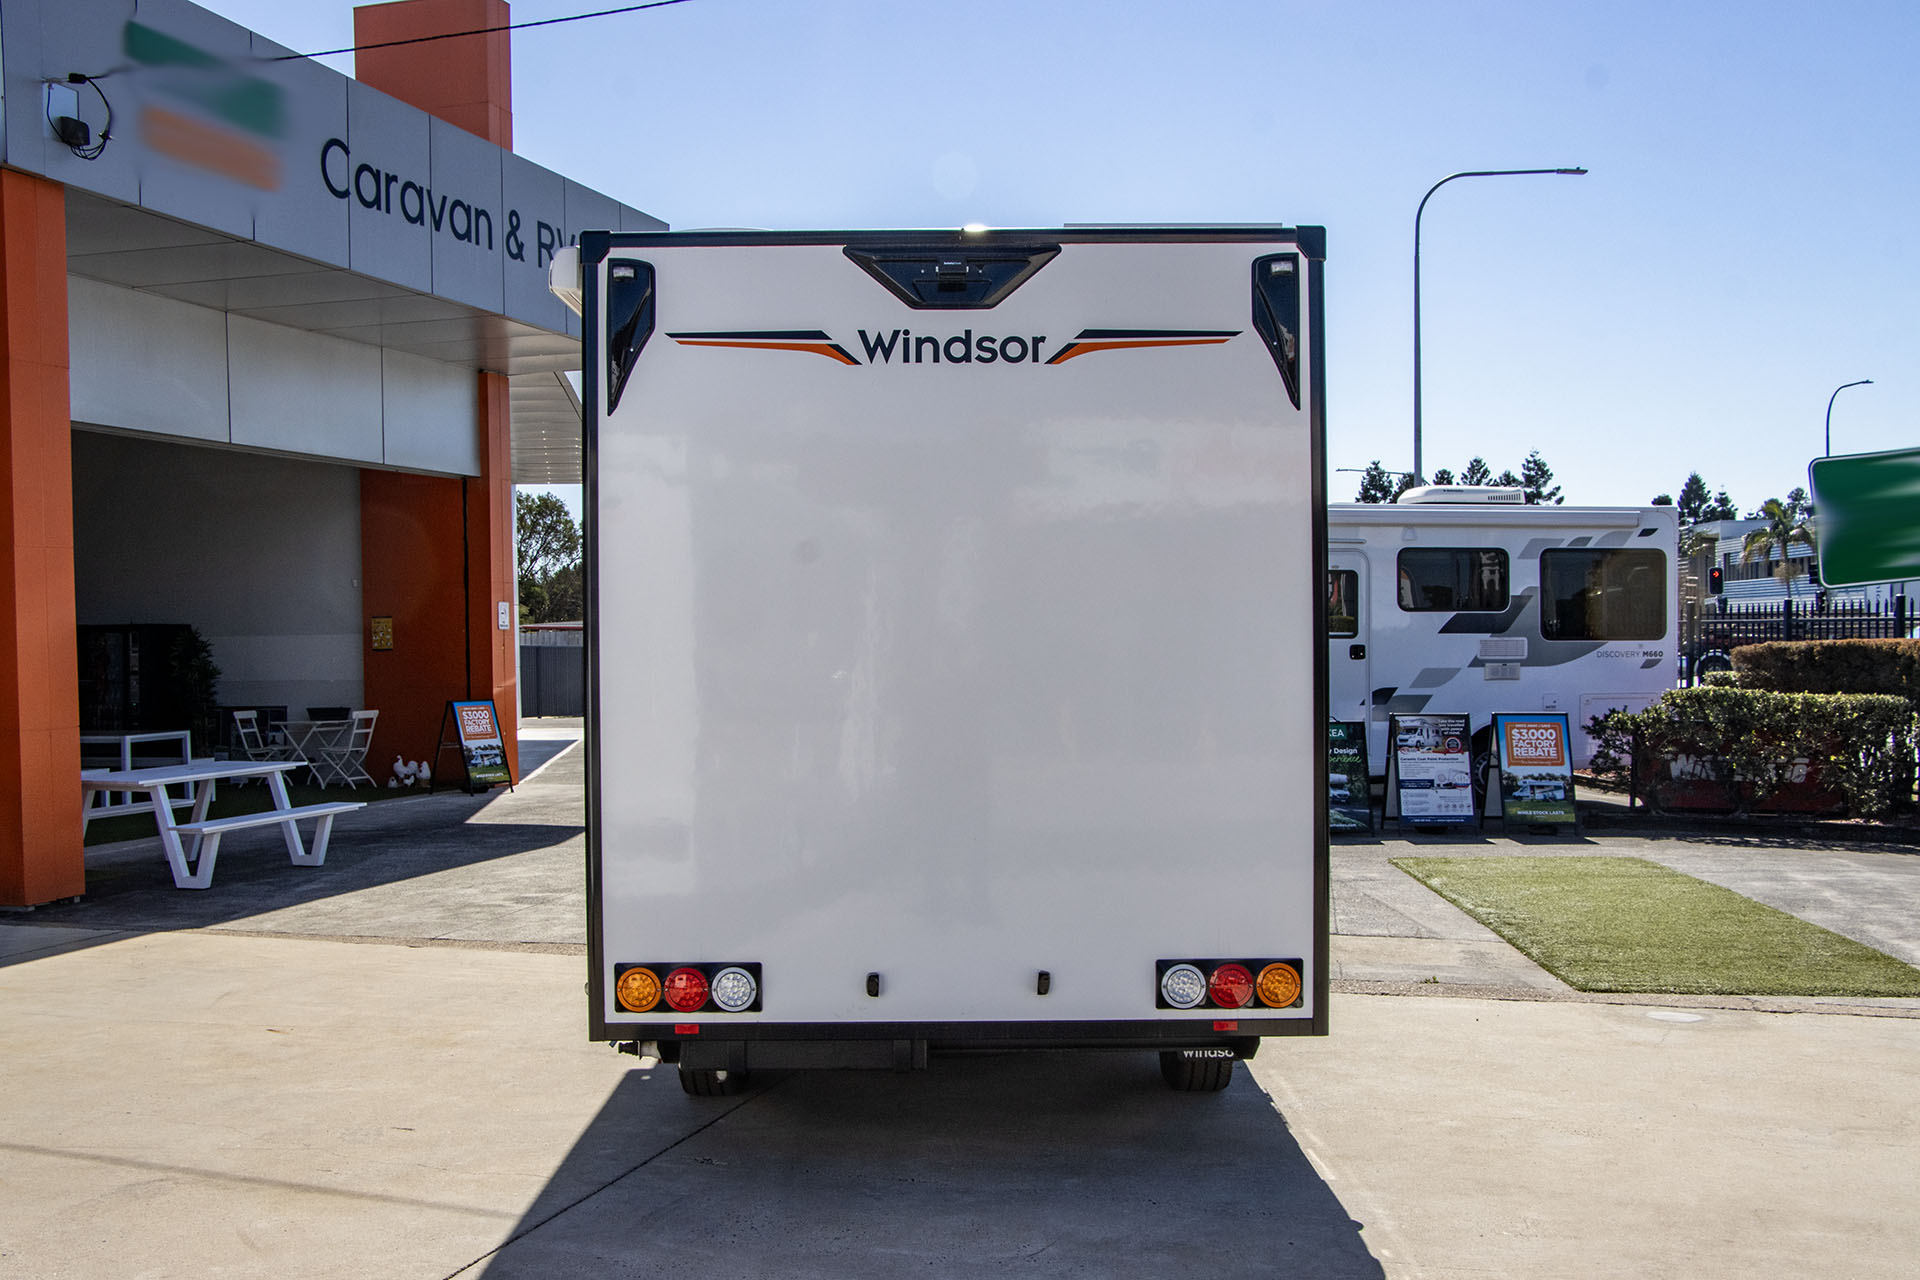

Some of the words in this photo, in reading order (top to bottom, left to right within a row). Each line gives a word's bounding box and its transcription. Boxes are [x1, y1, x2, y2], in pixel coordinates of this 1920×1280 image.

[321, 137, 493, 250] Caravan
[505, 209, 525, 262] &
[857, 328, 1047, 364] Windsor
[1596, 650, 1640, 658] DISCOVERY
[1642, 650, 1664, 658] M660
[465, 725, 492, 733] REBATE
[1513, 740, 1556, 748] FACTORY
[1334, 747, 1358, 755] Design
[1513, 748, 1557, 757] REBATE
[1183, 1050, 1234, 1058] Windso
